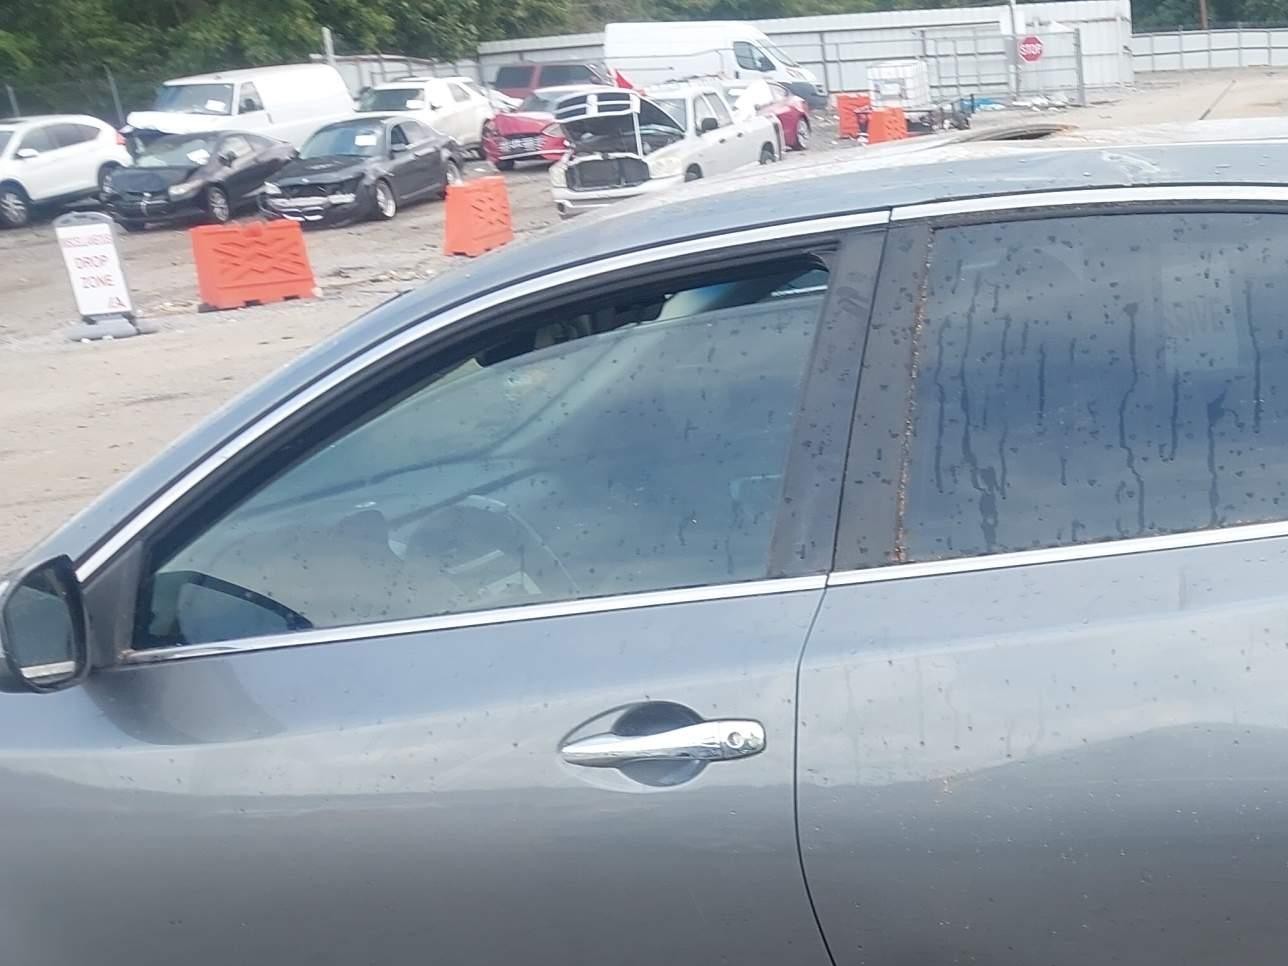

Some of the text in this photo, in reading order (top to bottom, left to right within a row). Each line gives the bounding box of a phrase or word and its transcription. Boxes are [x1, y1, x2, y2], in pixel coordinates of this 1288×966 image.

[1020, 43, 1042, 56] STOP
[74, 254, 108, 270] DROP
[80, 274, 115, 289] ZONE
